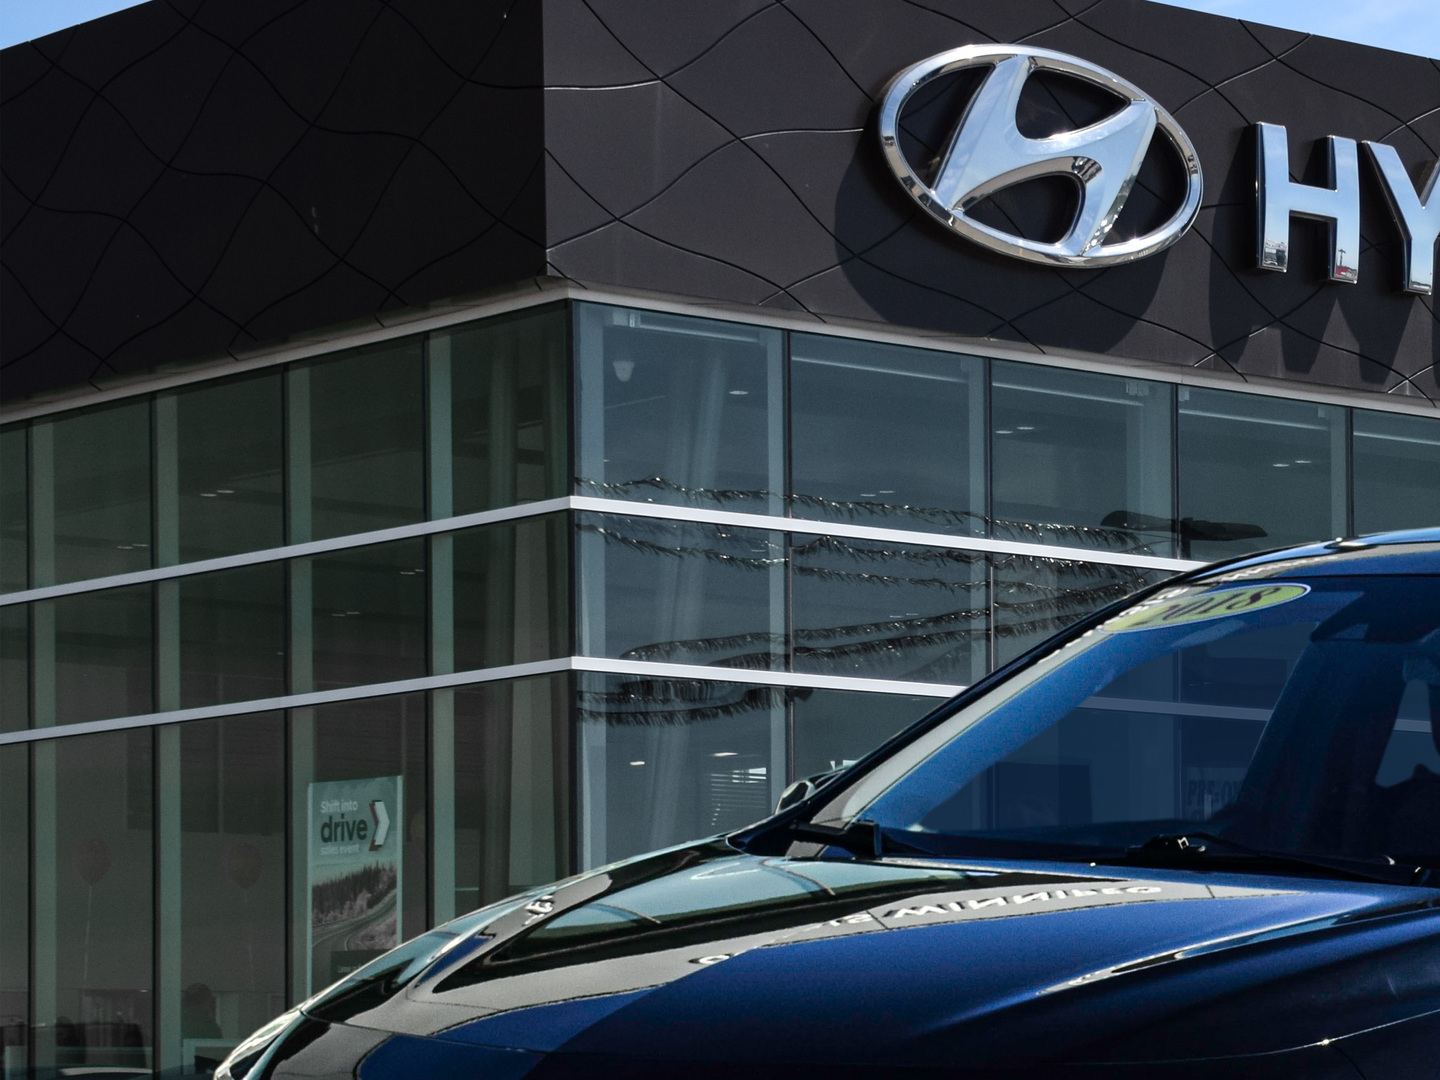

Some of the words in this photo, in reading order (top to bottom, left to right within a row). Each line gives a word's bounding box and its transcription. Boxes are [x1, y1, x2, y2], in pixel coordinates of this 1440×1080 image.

[320, 800, 340, 813] Shift
[341, 799, 359, 812] into
[320, 813, 368, 843] drive
